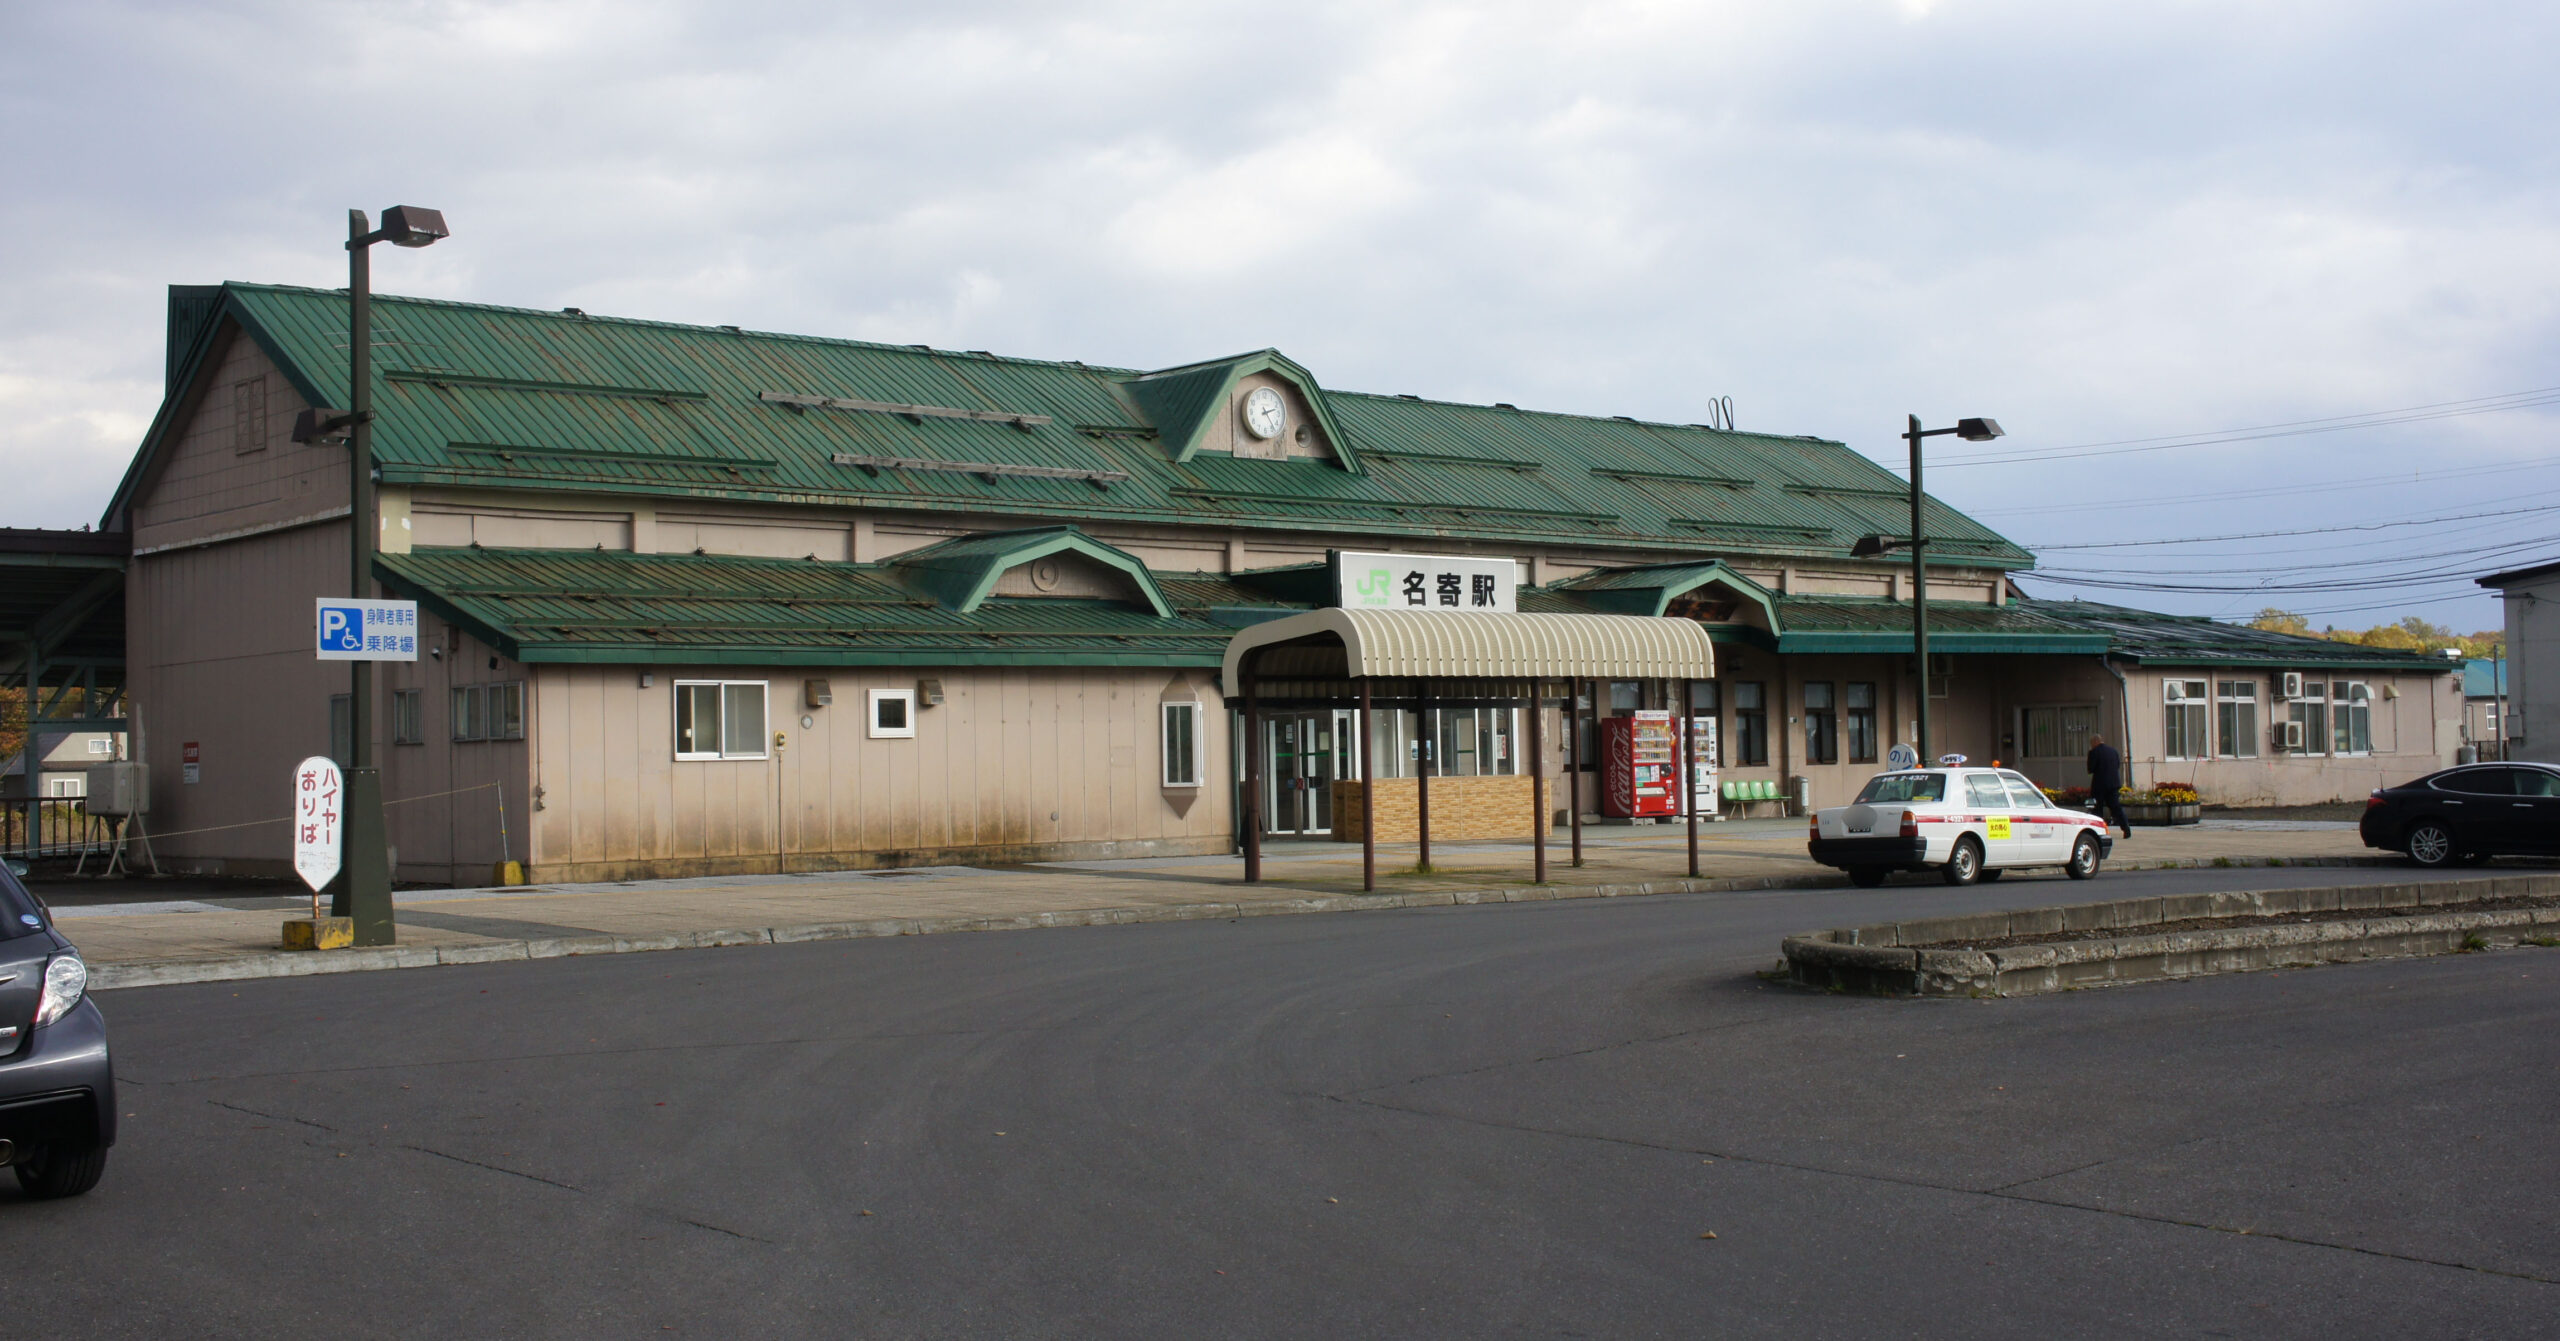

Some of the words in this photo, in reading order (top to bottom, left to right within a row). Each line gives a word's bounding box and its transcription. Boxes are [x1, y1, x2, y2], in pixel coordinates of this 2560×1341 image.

[1356, 569, 1391, 596] JR
[1402, 570, 1496, 608] 名寄駅
[323, 610, 347, 640] P
[366, 608, 414, 626] 身障者専用
[366, 635, 414, 653] 乗降場
[301, 770, 320, 844] おりば
[322, 768, 338, 845] ハイヤー
